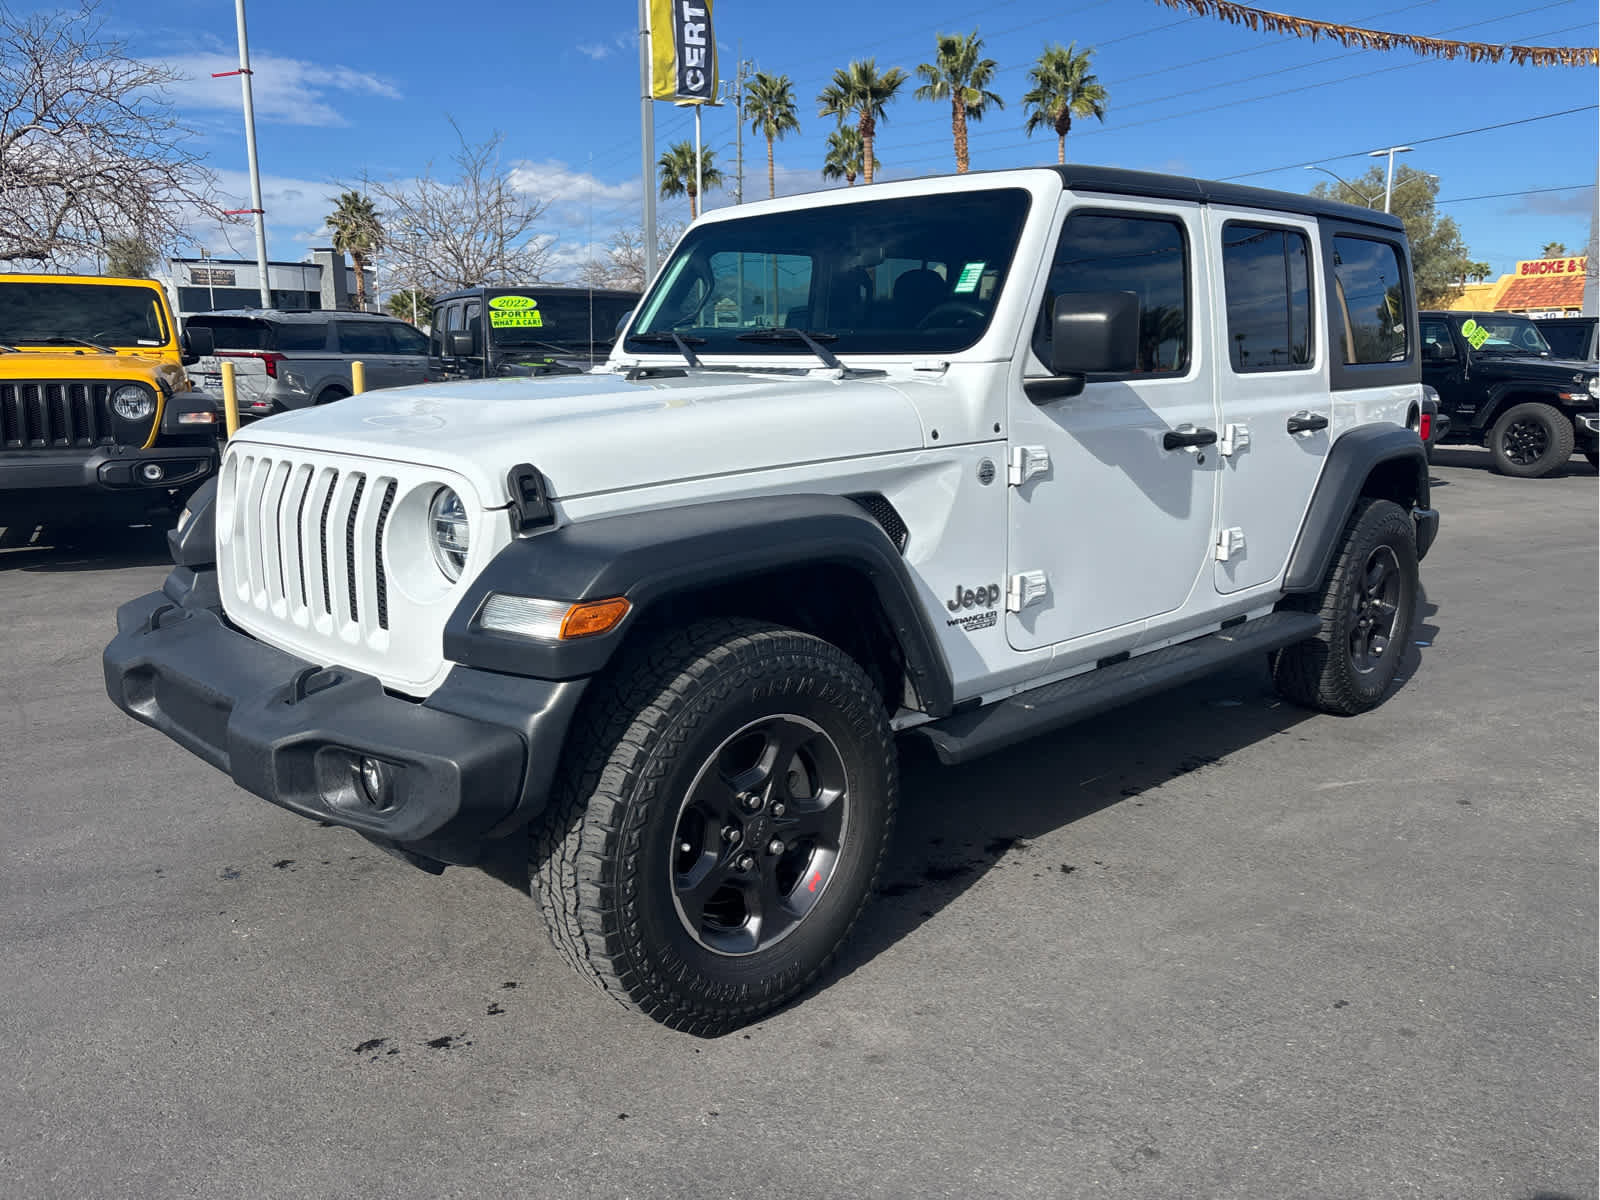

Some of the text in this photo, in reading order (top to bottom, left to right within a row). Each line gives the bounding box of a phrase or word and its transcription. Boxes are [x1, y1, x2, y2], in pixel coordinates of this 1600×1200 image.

[683, 0, 706, 92] CERT
[1521, 261, 1565, 275] SMOKE
[1567, 259, 1577, 272] &
[498, 299, 529, 308] 2022
[493, 319, 514, 327] WHAT
[494, 311, 535, 319] SPORTY
[947, 583, 1000, 612] Jeep
[946, 610, 998, 627] WRANGLER
